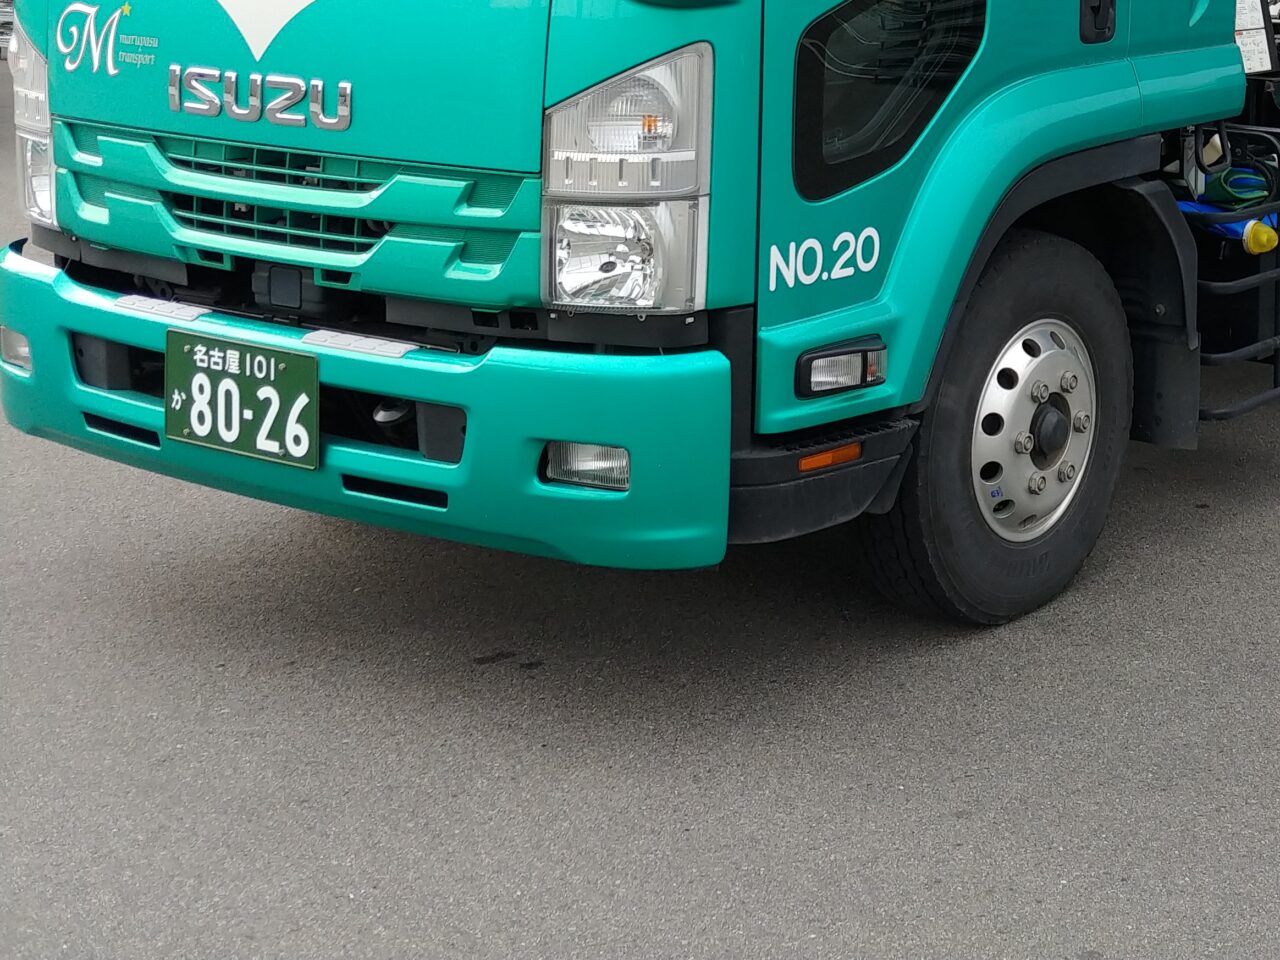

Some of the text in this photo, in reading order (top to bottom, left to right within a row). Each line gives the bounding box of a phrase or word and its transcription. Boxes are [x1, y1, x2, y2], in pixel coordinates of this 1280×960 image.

[168, 64, 352, 132] ISUZU
[769, 226, 880, 292] NO.20
[193, 343, 275, 381] 名古屋 101
[171, 372, 310, 458] か 80-26
